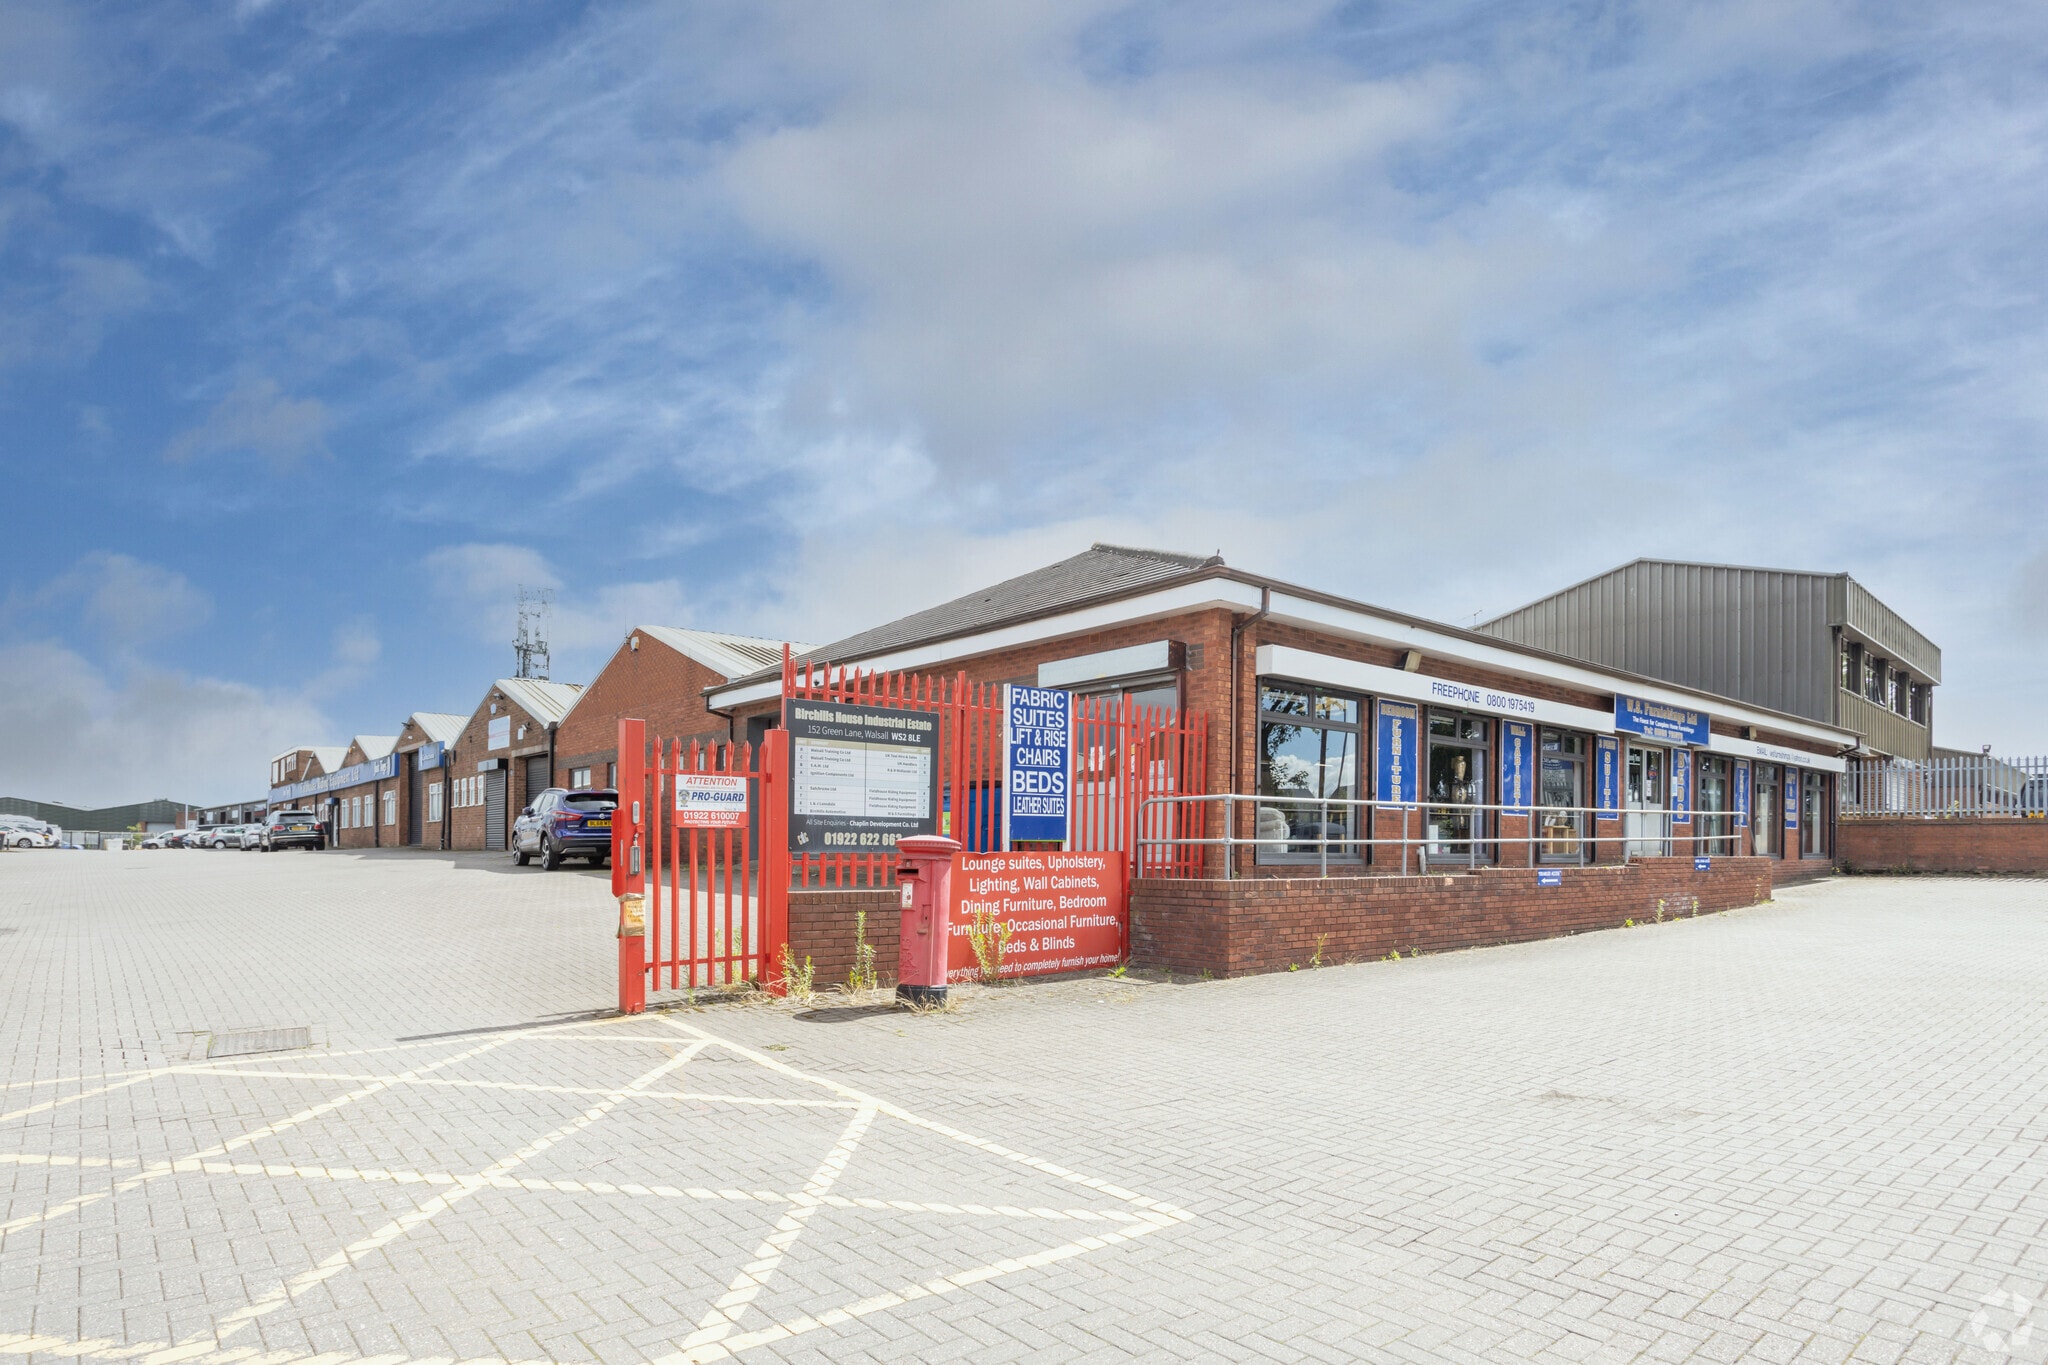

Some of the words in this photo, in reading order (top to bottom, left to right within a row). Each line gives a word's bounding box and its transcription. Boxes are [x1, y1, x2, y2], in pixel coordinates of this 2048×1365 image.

[1012, 688, 1065, 709] FABRIC
[1432, 682, 1480, 703] FREEPHONE
[1486, 694, 1507, 708] 0800
[1507, 698, 1535, 713] 1975419
[795, 707, 834, 722] Birchills
[835, 712, 863, 725] House
[864, 714, 906, 729] Industrial
[907, 718, 932, 731] Estate
[1013, 708, 1065, 728] SUITES
[808, 725, 821, 735] 152
[822, 726, 844, 737] Green
[844, 728, 864, 739] Lane,
[864, 730, 889, 740] Walsall
[891, 732, 908, 742] WS2
[908, 734, 921, 743] 8LE
[1011, 728, 1032, 744] LIFT
[1034, 729, 1042, 746] &
[1044, 730, 1066, 748] RISE
[1017, 747, 1061, 766] CHAIRS
[1391, 719, 1402, 802] FURNITURE
[686, 777, 738, 786] ATTENTION
[1013, 770, 1064, 794] BEDS
[1677, 751, 1685, 820] BEDS
[691, 792, 744, 802] PRO-GUARD
[1013, 796, 1042, 814] LEATHER
[1042, 797, 1065, 815] SUITES
[683, 812, 709, 820] 01922
[711, 812, 740, 820] 610007
[824, 820, 846, 828] Enquiries
[849, 820, 869, 828] Chaplin
[869, 821, 902, 829] Development
[824, 832, 858, 846] 01922
[860, 832, 880, 846] 622
[962, 857, 1006, 873] Lounge
[1008, 857, 1045, 871] suites,
[1048, 855, 1106, 872] Upholstery,
[969, 877, 1020, 895] Lighting,
[1023, 876, 1048, 891] Wall
[1051, 875, 1100, 890] Cabinets,
[961, 899, 1000, 916] Dining
[1003, 898, 1057, 912] Furniture,
[1059, 896, 1107, 909] Bedroom
[1007, 915, 1067, 933] Occasional
[1070, 914, 1119, 929] Furniture,
[1029, 938, 1040, 952] &
[1042, 936, 1075, 950] Blinds
[946, 966, 979, 980] verything
[1014, 962, 1022, 972] to
[1023, 958, 1060, 972] completely
[1061, 955, 1084, 967] furnish
[1084, 956, 1099, 967] your
